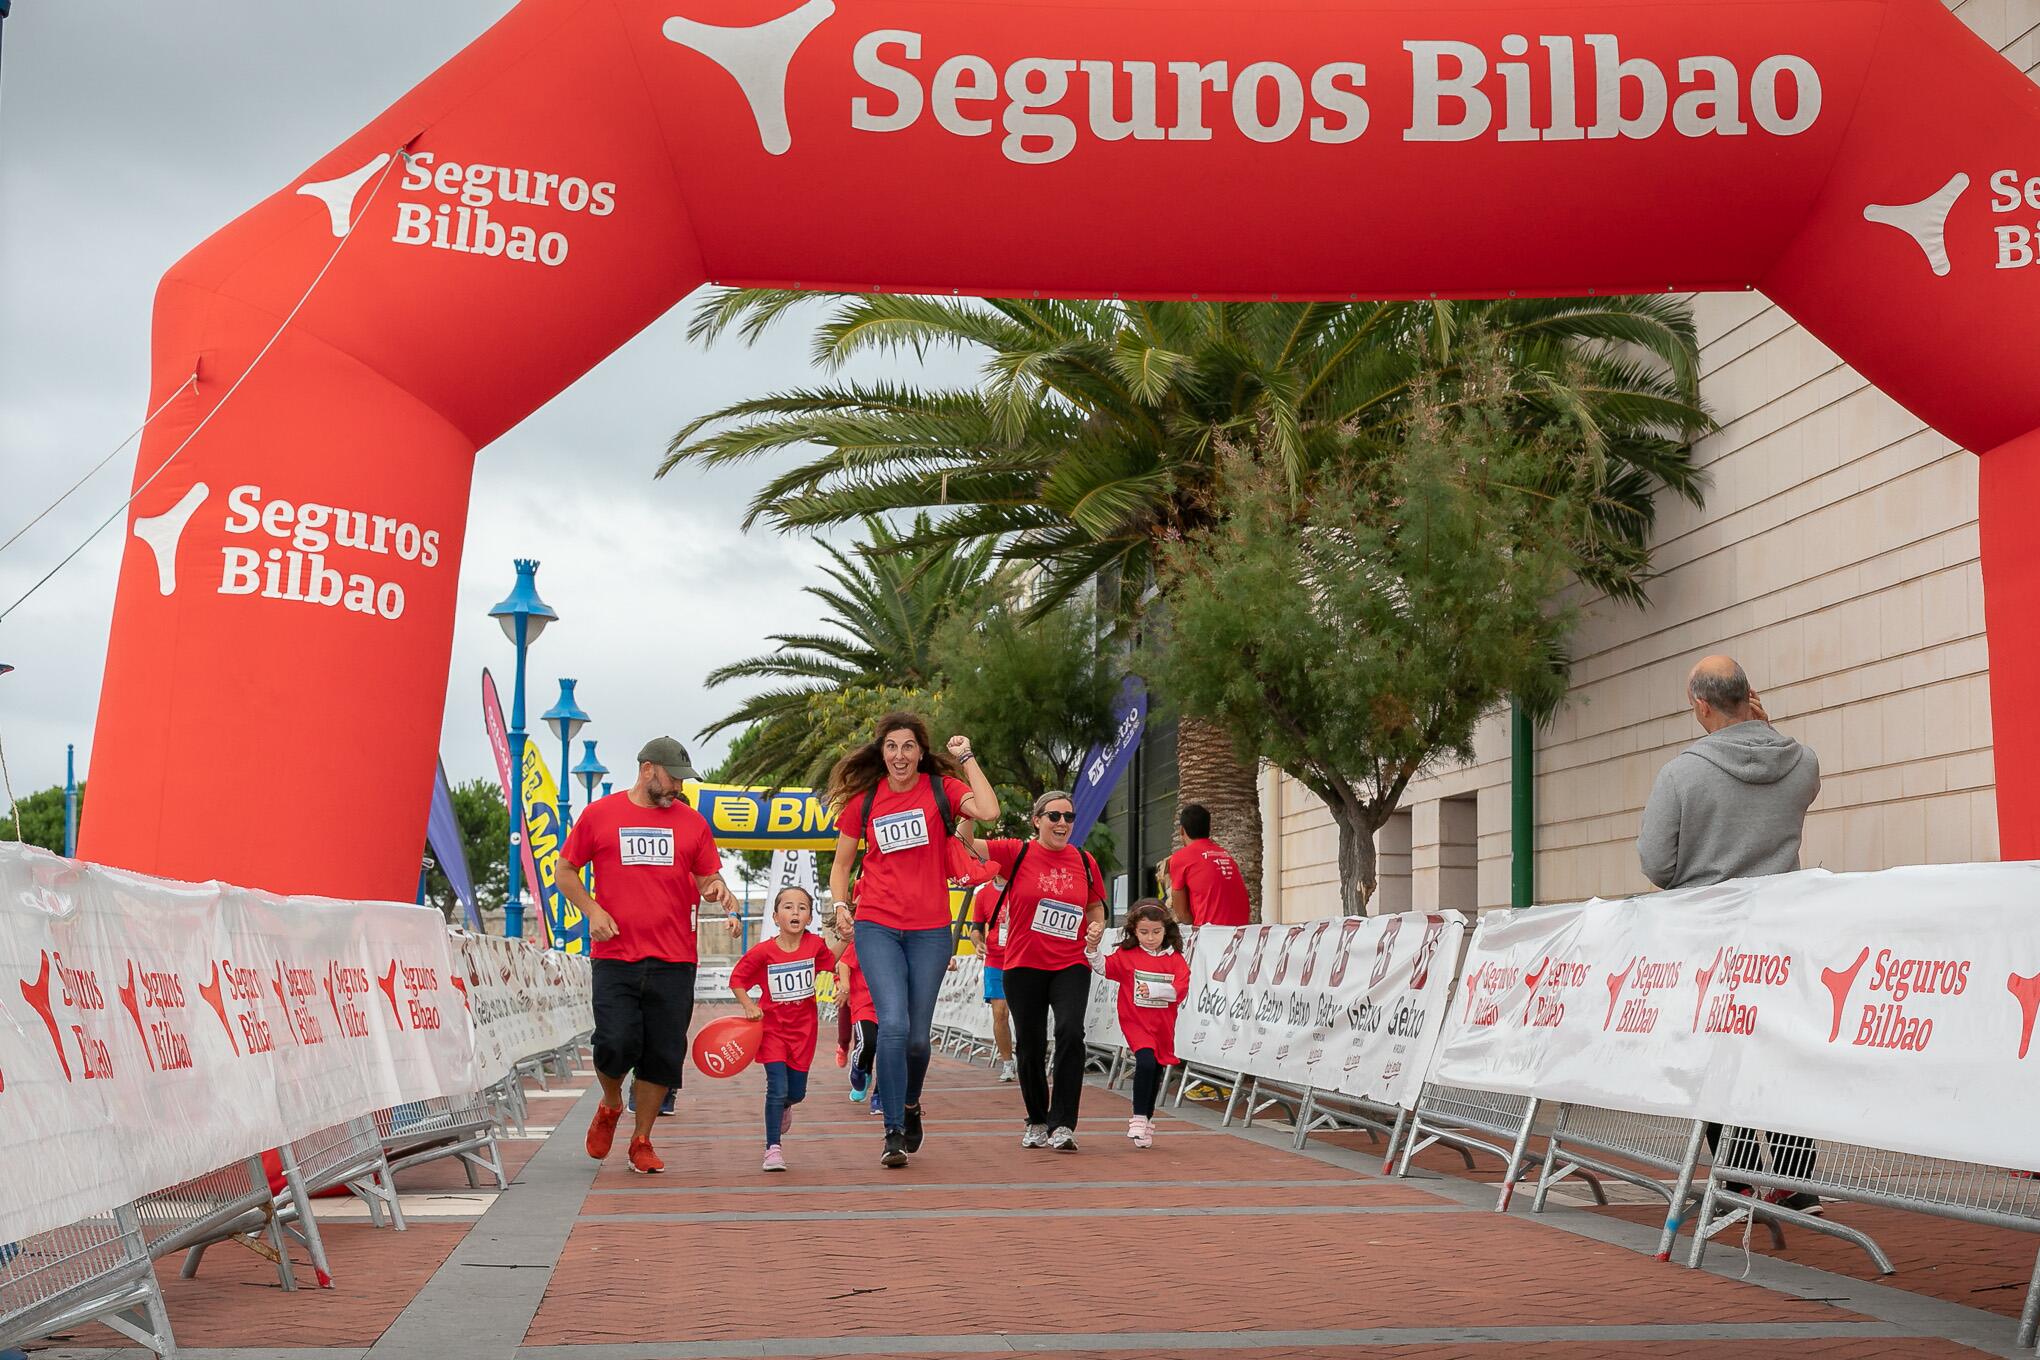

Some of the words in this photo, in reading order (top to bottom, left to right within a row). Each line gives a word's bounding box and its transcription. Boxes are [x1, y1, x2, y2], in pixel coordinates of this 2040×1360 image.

[852, 29, 1369, 164] Seguros
[1403, 34, 1822, 143] Bilbao
[400, 152, 617, 217] Seguros
[392, 203, 569, 266] Bilbao
[224, 485, 440, 568] Seguros
[217, 546, 405, 620] Bilbao
[627, 838, 668, 856] 1010
[881, 820, 922, 843] 1010
[1042, 909, 1077, 931] 1010
[53, 952, 104, 1010] Suros
[774, 970, 812, 991] 1010
[1631, 956, 1683, 997] Seguros
[1869, 949, 1971, 1001] Seguros
[1255, 990, 1283, 1023] Getxo
[1347, 995, 1382, 1033] Getxo
[1388, 996, 1425, 1039] Getxo
[1615, 999, 1659, 1034] Bilbao
[1705, 993, 1758, 1035] Bilbao
[1852, 1004, 1934, 1051] Bilbao
